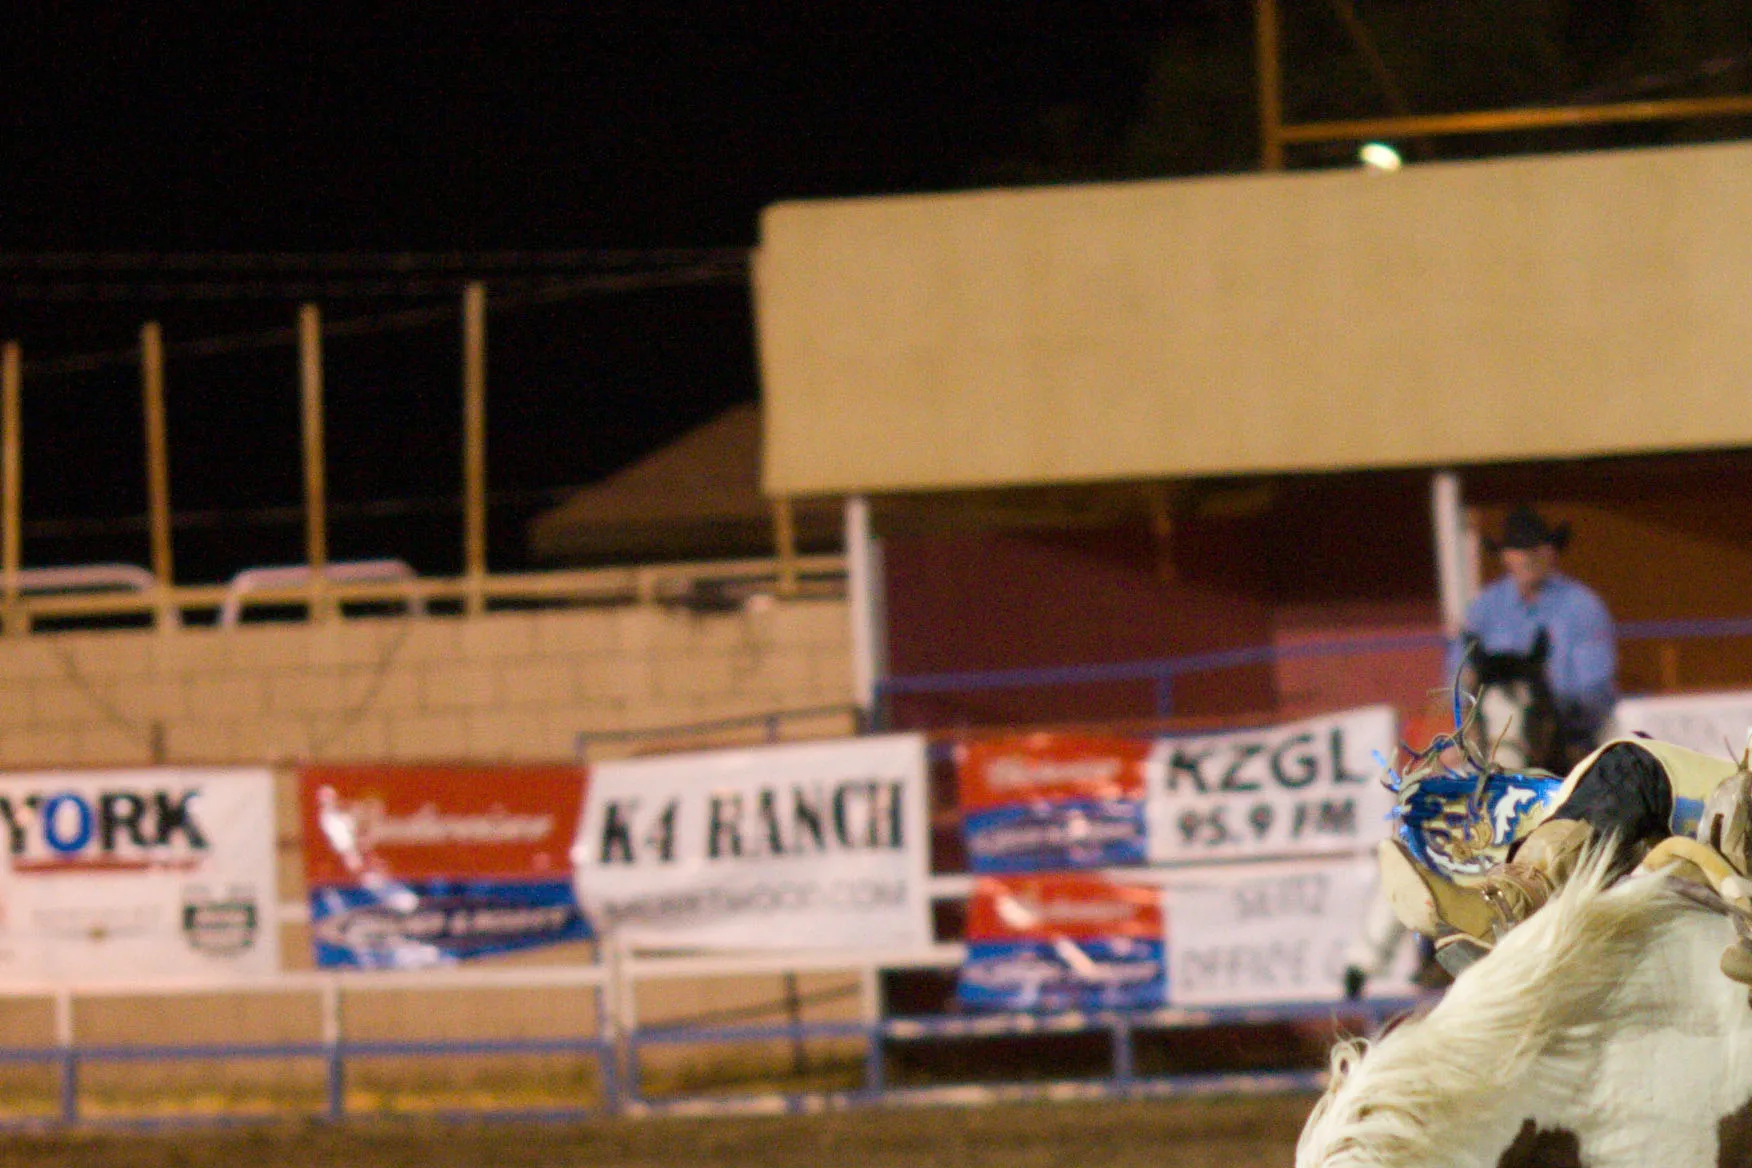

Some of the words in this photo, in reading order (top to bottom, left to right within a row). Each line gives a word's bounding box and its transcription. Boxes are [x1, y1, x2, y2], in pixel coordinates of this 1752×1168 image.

[1165, 727, 1371, 794] KZGL
[0, 788, 211, 855] YORK
[706, 780, 906, 859] RANCH
[1176, 804, 1275, 848] 95.9
